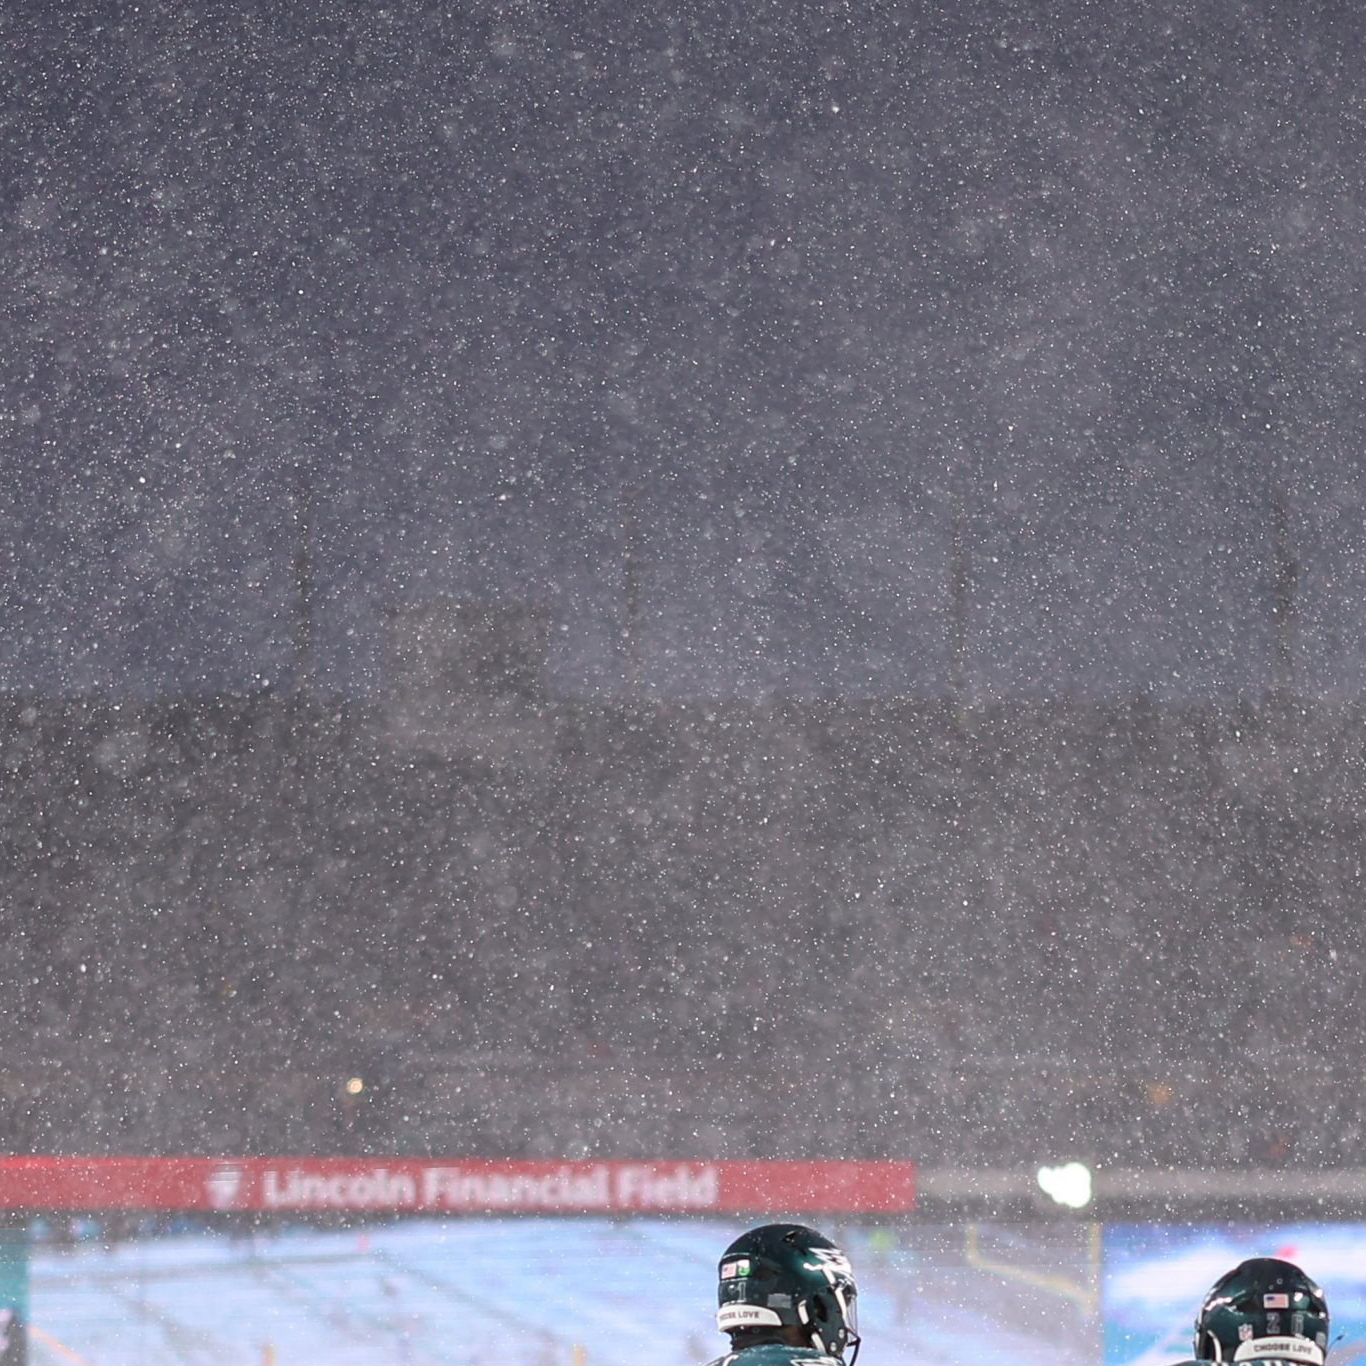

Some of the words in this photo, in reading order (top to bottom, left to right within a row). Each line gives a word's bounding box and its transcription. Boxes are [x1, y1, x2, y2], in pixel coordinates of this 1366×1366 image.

[263, 1168, 415, 1205] Lincoln
[423, 1167, 609, 1205] Financial
[618, 1166, 717, 1205] Field
[738, 1311, 760, 1319] LOVE
[1253, 1343, 1291, 1353] CHOOSE
[1292, 1344, 1312, 1354] LOVE
